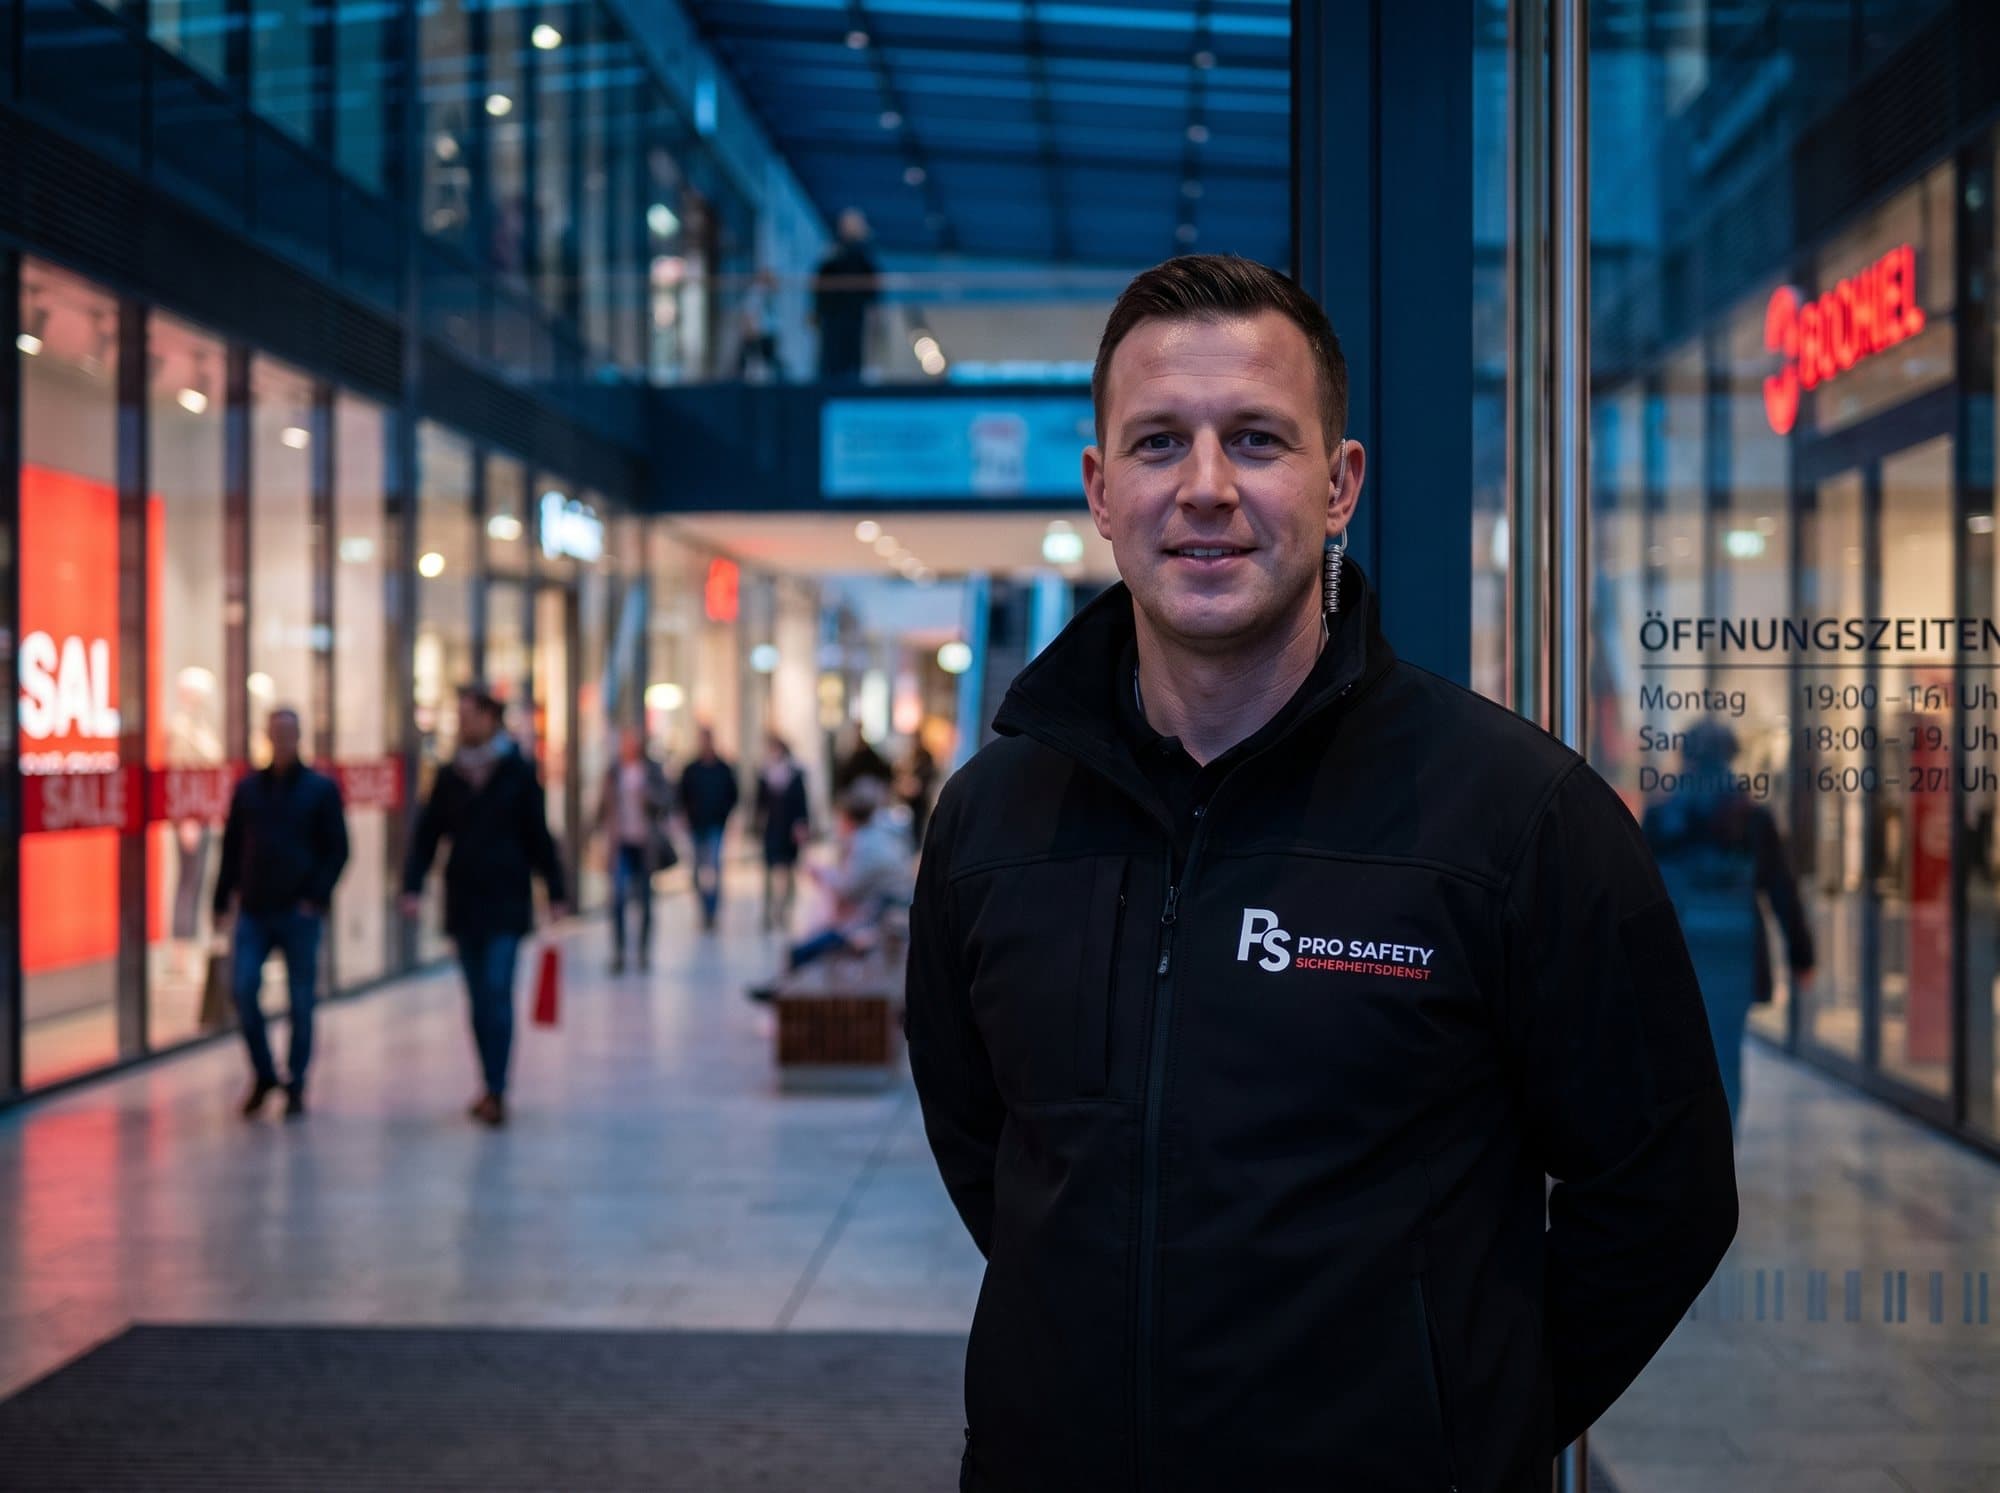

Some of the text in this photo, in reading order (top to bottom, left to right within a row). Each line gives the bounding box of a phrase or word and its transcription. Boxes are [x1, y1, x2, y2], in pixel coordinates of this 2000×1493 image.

[1639, 611, 2000, 651] ÖFFNUNGSZEITEN
[1639, 684, 1746, 718] Montag
[1803, 684, 1878, 711] 19:00
[1803, 725, 1878, 752] 18:00
[1802, 766, 1878, 793] 16:00
[1237, 907, 1292, 973] PS
[1298, 936, 1434, 966] PRO SAFETY
[1295, 957, 1432, 981] SICHERHEITSDIENST
